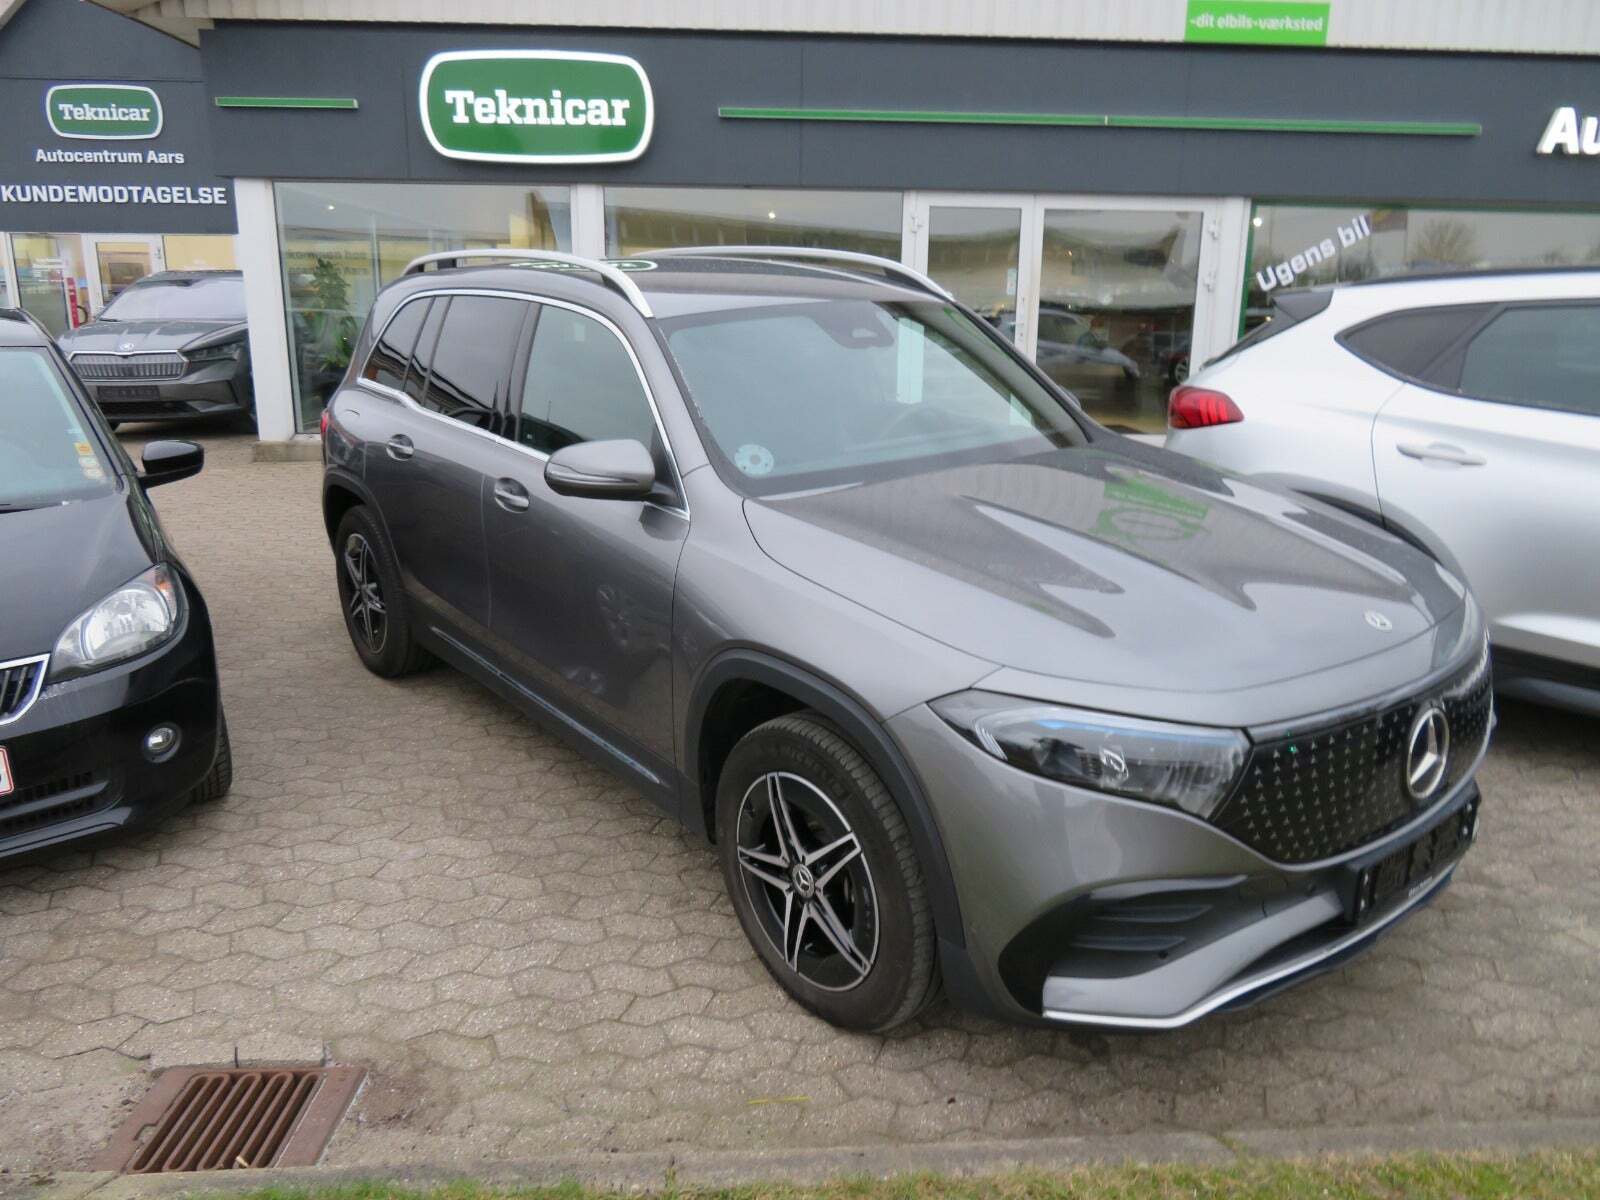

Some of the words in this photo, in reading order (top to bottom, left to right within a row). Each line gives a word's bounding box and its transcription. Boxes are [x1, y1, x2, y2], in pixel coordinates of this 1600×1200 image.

[58, 103, 151, 121] Teknicar
[444, 89, 630, 126] Teknicar
[35, 149, 143, 163] Autocentrum
[146, 150, 185, 164] Aars
[0, 185, 227, 204] KUNDEMODTAGELSE
[1256, 238, 1336, 291] Ugens
[1337, 214, 1371, 248] bil
